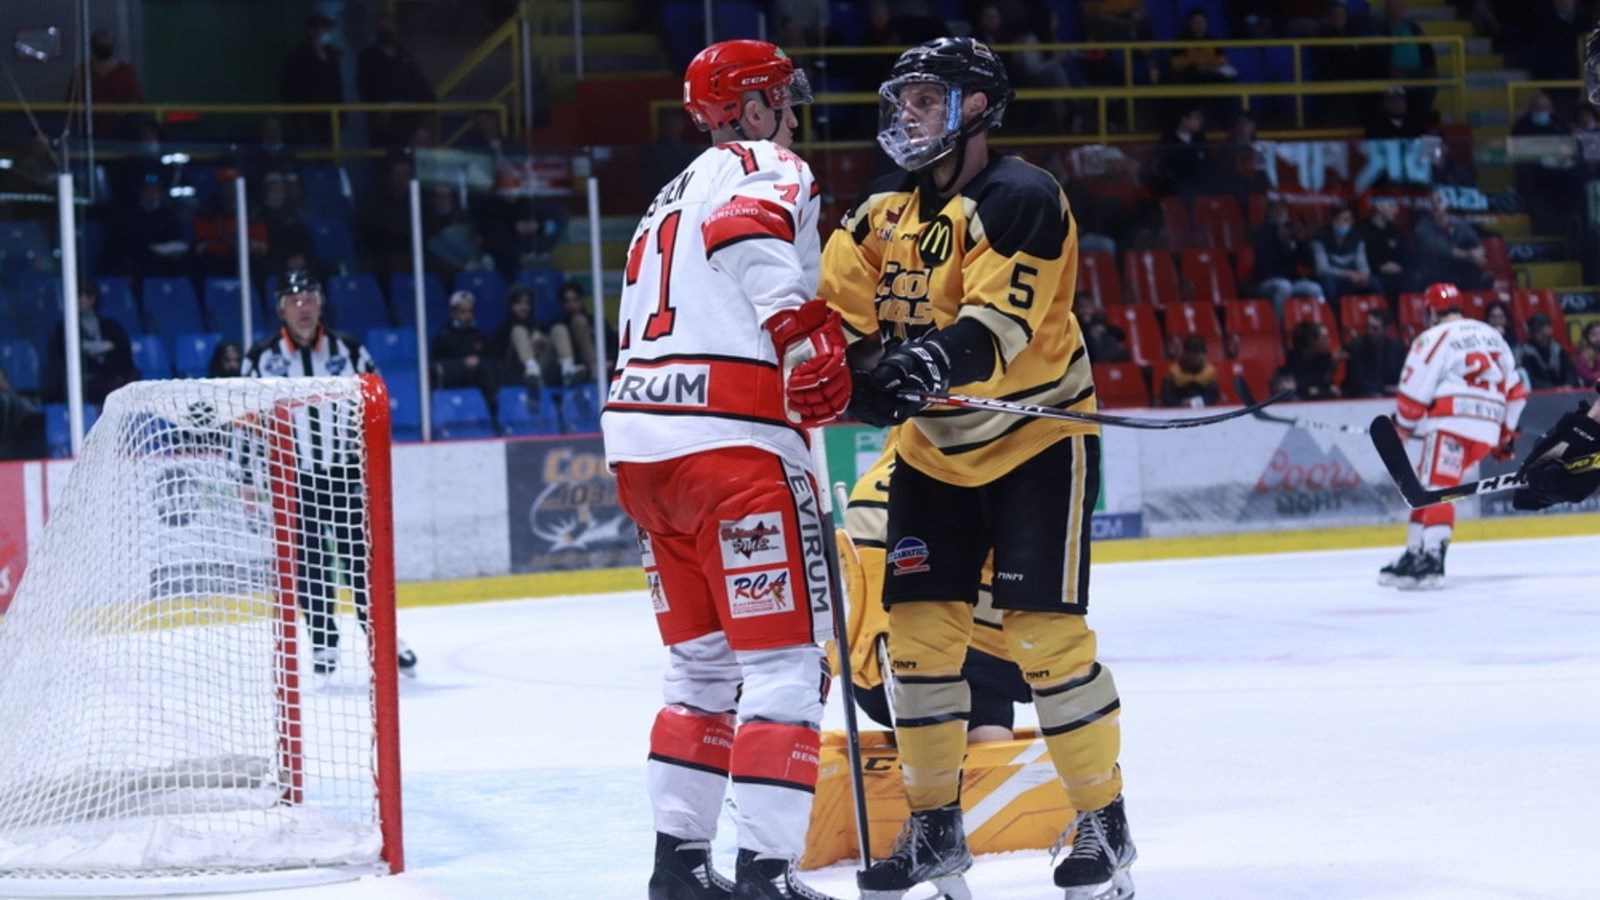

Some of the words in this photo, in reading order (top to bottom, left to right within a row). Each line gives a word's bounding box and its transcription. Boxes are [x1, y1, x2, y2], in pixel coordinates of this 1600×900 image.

[741, 76, 768, 86] CCM
[1007, 262, 1038, 311] 5
[611, 372, 707, 405] RUM
[790, 475, 830, 613] EVIRUM
[734, 571, 788, 600] RCA
